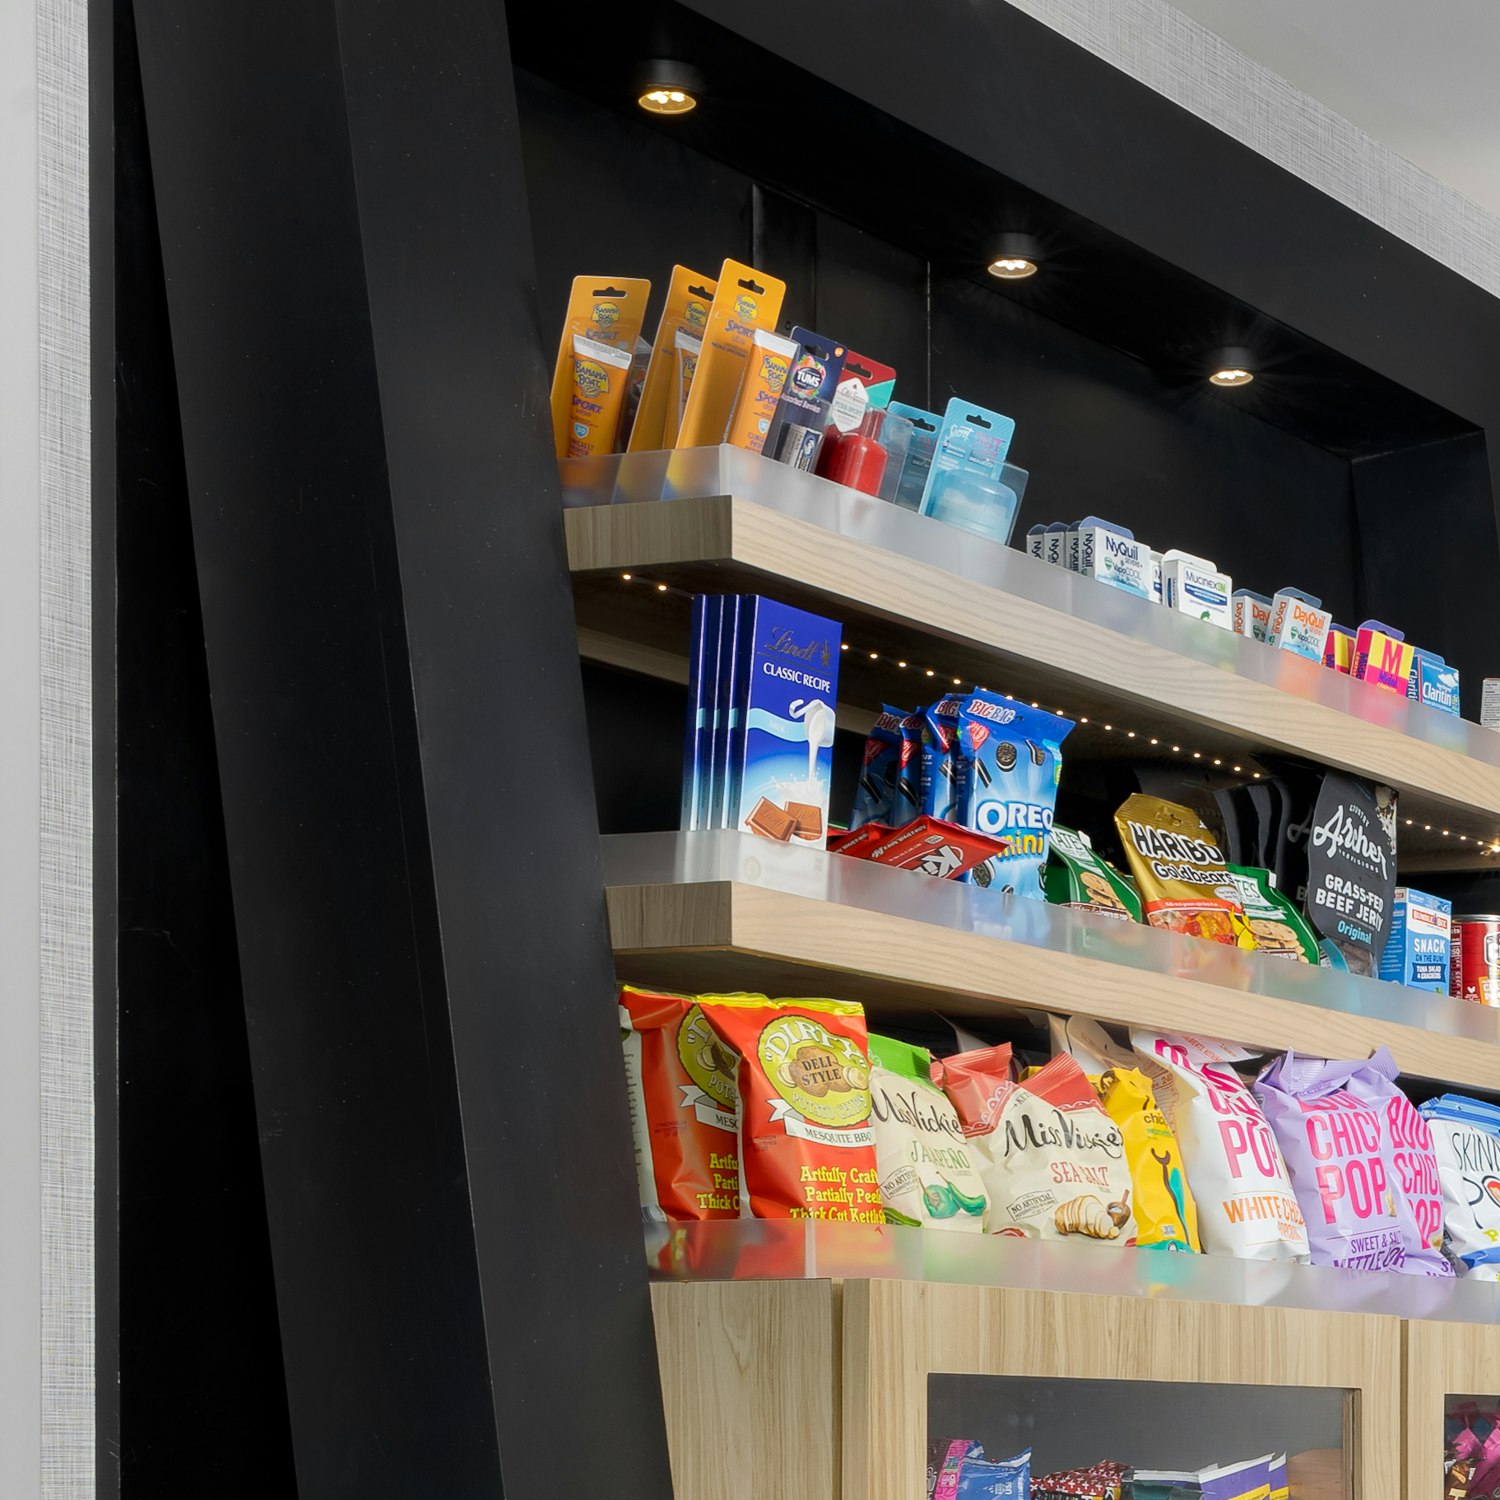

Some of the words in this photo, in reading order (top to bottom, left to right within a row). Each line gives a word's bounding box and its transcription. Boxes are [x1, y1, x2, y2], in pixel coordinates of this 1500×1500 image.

[797, 371, 821, 388] TUMS
[1083, 533, 1094, 568] NyQuil
[1106, 536, 1139, 561] NyQuil
[1293, 605, 1326, 630] DayQuil
[763, 661, 803, 685] CLASSIC
[802, 674, 831, 694] RECIPE
[1423, 682, 1451, 706] Claritin
[967, 699, 995, 717] BIG
[990, 706, 1017, 725] BAG
[977, 800, 1056, 835] OREO
[1349, 803, 1371, 828] COUNTRY
[1127, 821, 1225, 865] HARIBO
[1312, 804, 1388, 881] Archer
[1152, 860, 1236, 885] Goldbears
[1315, 887, 1354, 914] BEEF
[1324, 873, 1385, 914] GRASS-FED
[1336, 919, 1373, 946] Original
[1413, 937, 1446, 954] SNACK
[1415, 954, 1425, 962] ON
[1425, 954, 1433, 962] THE
[801, 1068, 842, 1086] STYLE
[792, 1089, 836, 1121] POTATO
[836, 1093, 869, 1119] CHIPS
[804, 1127, 853, 1144] MESQUITE
[853, 1130, 873, 1144] BBQ
[1004, 1114, 1061, 1157] Miss
[800, 1166, 847, 1187] Artfully
[883, 1181, 896, 1193] NO
[1050, 1161, 1082, 1185] SEA
[1081, 1166, 1110, 1188] SALT
[1393, 1152, 1443, 1197] CHIC
[696, 1193, 731, 1211] Thick
[806, 1186, 854, 1206] Partially
[1011, 1203, 1023, 1214] NO
[1022, 1192, 1054, 1210] ARTIFICIAL
[1315, 1156, 1386, 1225] POP
[790, 1207, 827, 1220] Thick
[828, 1207, 848, 1221] Cut
[1222, 1195, 1282, 1225] WHITE
[1351, 1233, 1380, 1254] SWEET
[1382, 1233, 1388, 1247] &
